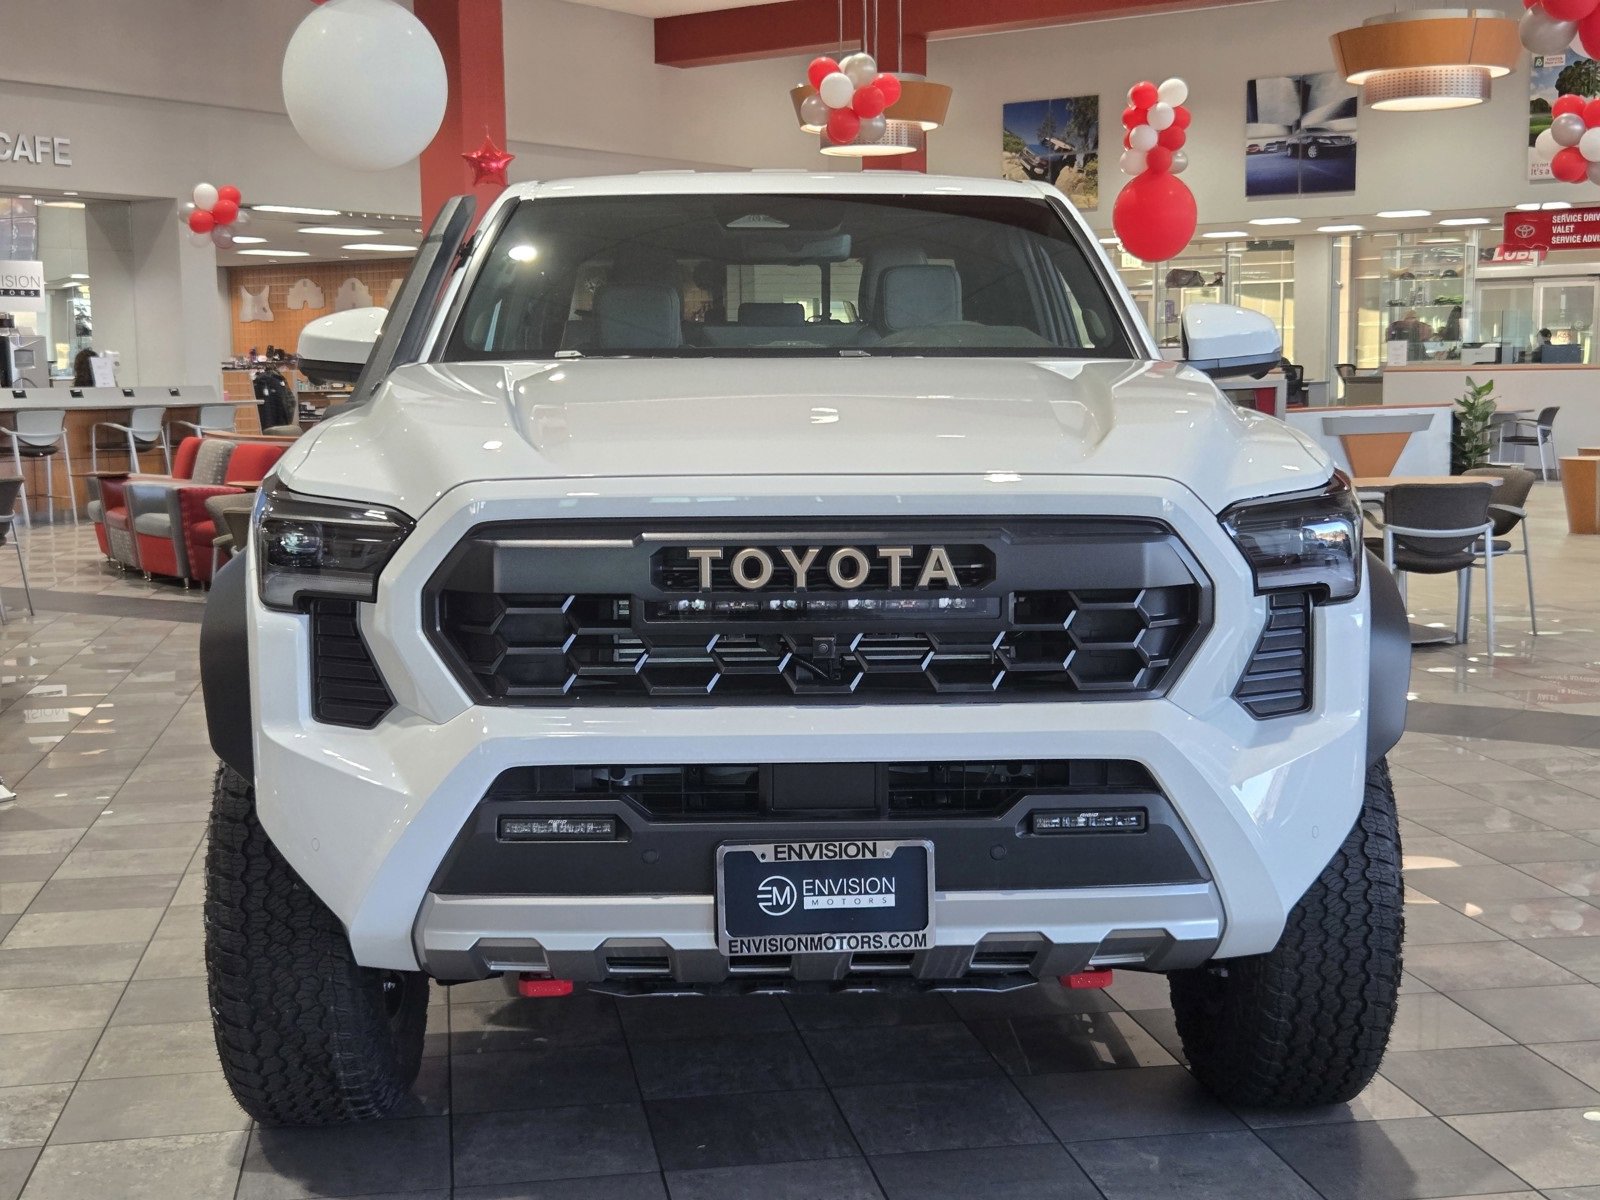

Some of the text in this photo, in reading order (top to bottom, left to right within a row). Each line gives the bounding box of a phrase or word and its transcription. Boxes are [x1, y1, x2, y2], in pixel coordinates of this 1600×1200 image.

[0, 132, 72, 166] CAFE
[1552, 214, 1582, 223] SERVICE
[1552, 225, 1575, 234] VALET
[1551, 235, 1582, 245] SERVICE
[1, 275, 41, 288] ISION
[686, 546, 962, 593] TOYOTA
[773, 842, 877, 861] ENVISION
[802, 877, 896, 896] ENVISION
[811, 896, 888, 907] MOTORS
[728, 933, 928, 955] ENVISIONMOTORS.COM
